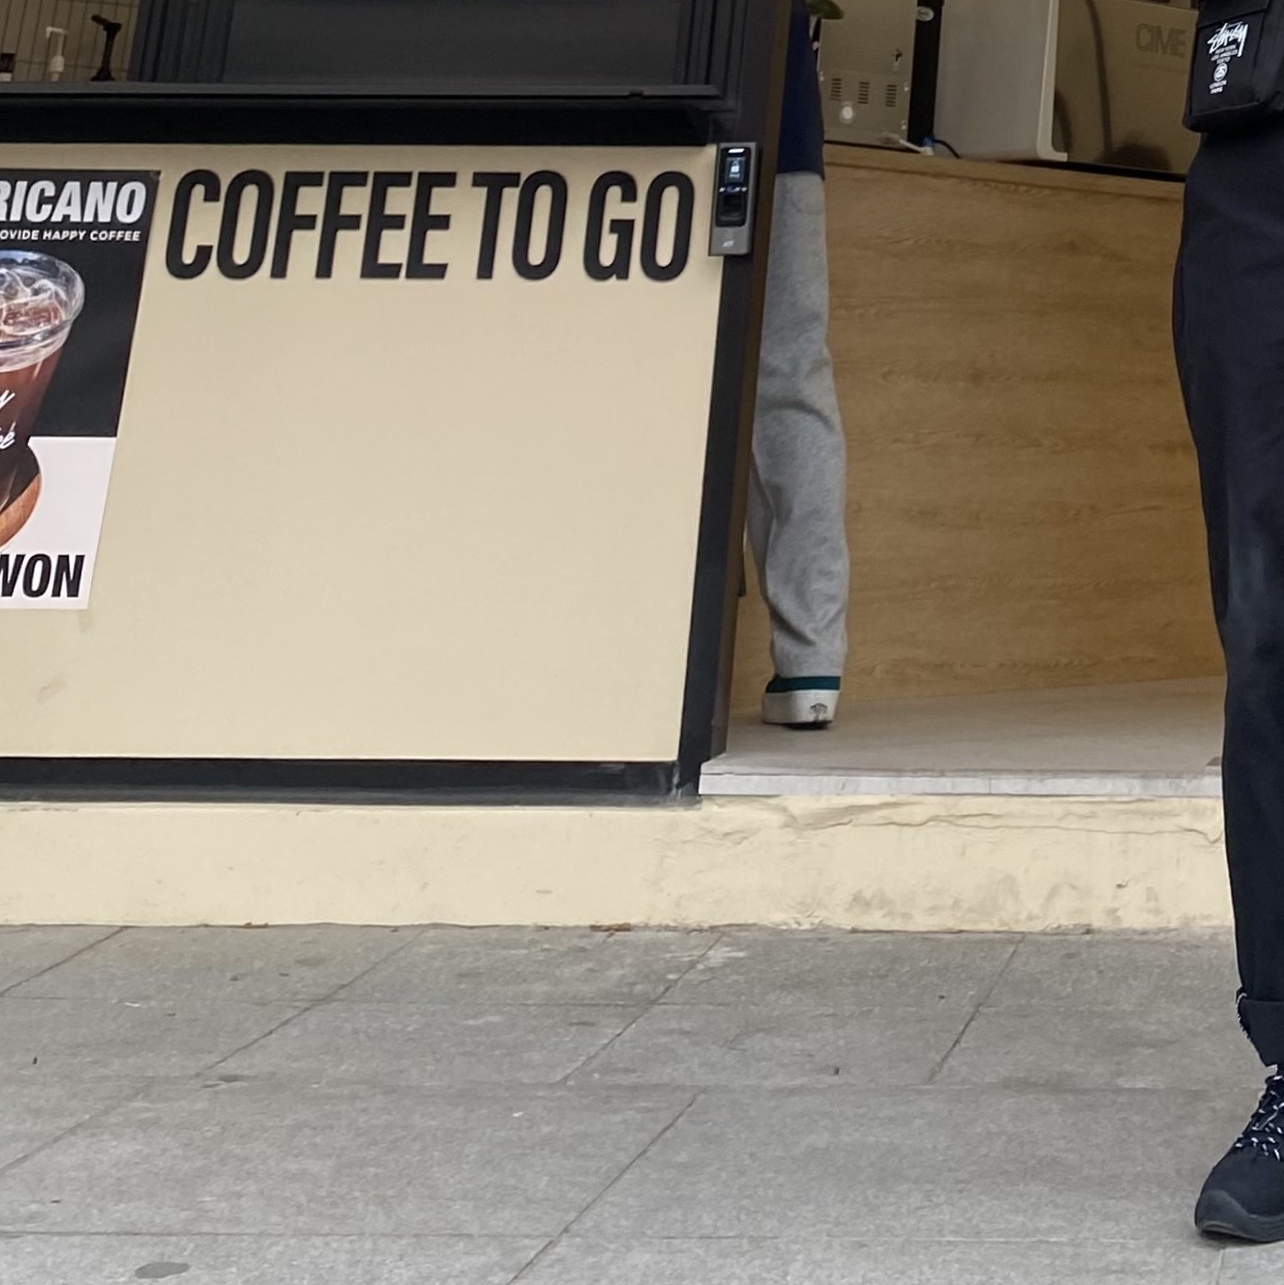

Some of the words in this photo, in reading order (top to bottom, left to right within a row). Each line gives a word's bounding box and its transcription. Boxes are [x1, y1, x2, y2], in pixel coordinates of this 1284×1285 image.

[42, 229, 87, 241] HAPPY
[90, 230, 141, 242] COFFEE
[165, 169, 457, 281] COFFEE
[472, 171, 568, 282] TO
[584, 171, 695, 283] GO
